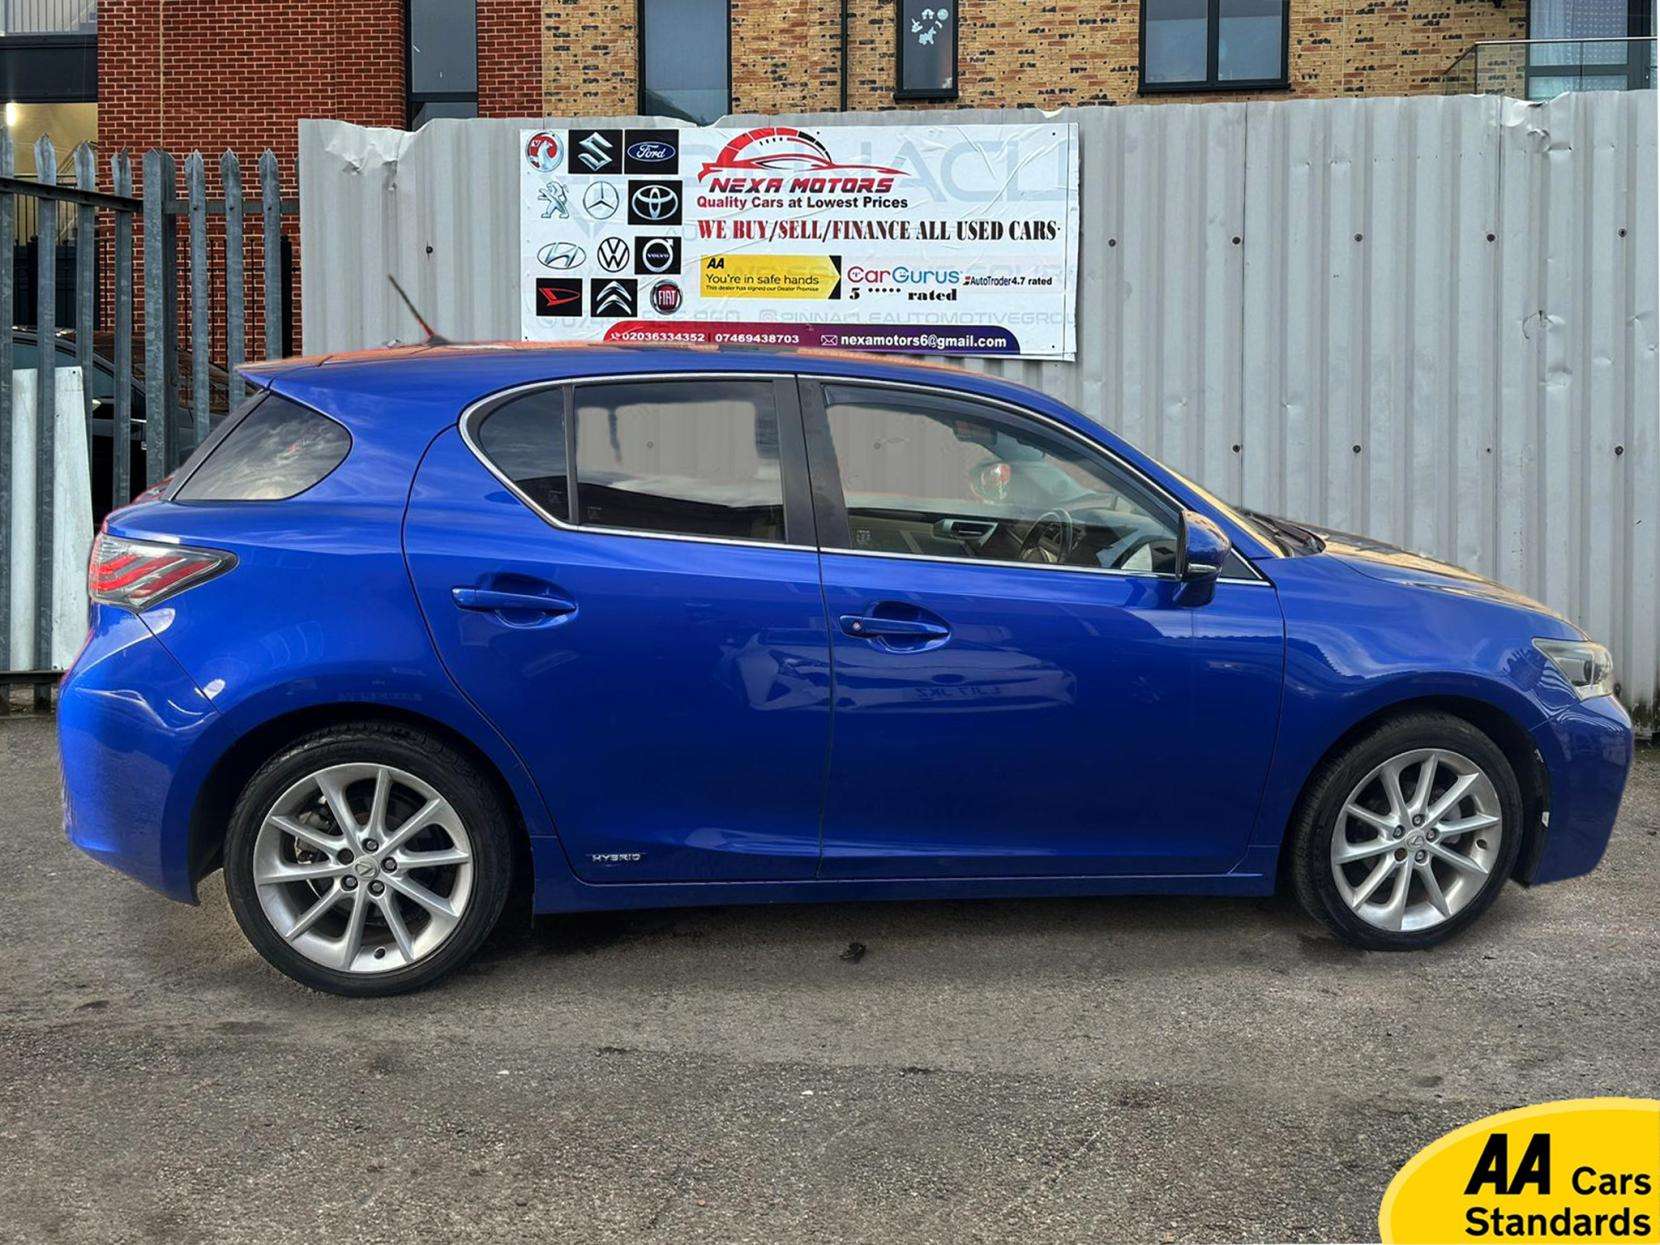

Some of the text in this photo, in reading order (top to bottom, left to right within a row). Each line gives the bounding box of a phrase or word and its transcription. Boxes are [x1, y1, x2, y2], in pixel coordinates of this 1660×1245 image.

[636, 144, 666, 159] Ford
[709, 177, 894, 194] NEXA MOTORS
[697, 195, 908, 210] Quality Cars at Lowest Prices
[697, 220, 727, 240] WE
[916, 221, 951, 240] ALL
[956, 221, 1004, 240] USED
[1008, 220, 1057, 241] CARS
[706, 257, 725, 269] AA
[706, 273, 819, 286] You're in safe hands
[847, 265, 960, 285] CarGurus
[1028, 276, 1053, 286] rated
[657, 289, 677, 306] FIAT
[849, 287, 957, 301] 5 rated
[622, 331, 800, 344] 02036334352 07469438703
[840, 334, 1008, 349] nexamotors6@gmail.com
[592, 853, 641, 862] HYBRID
